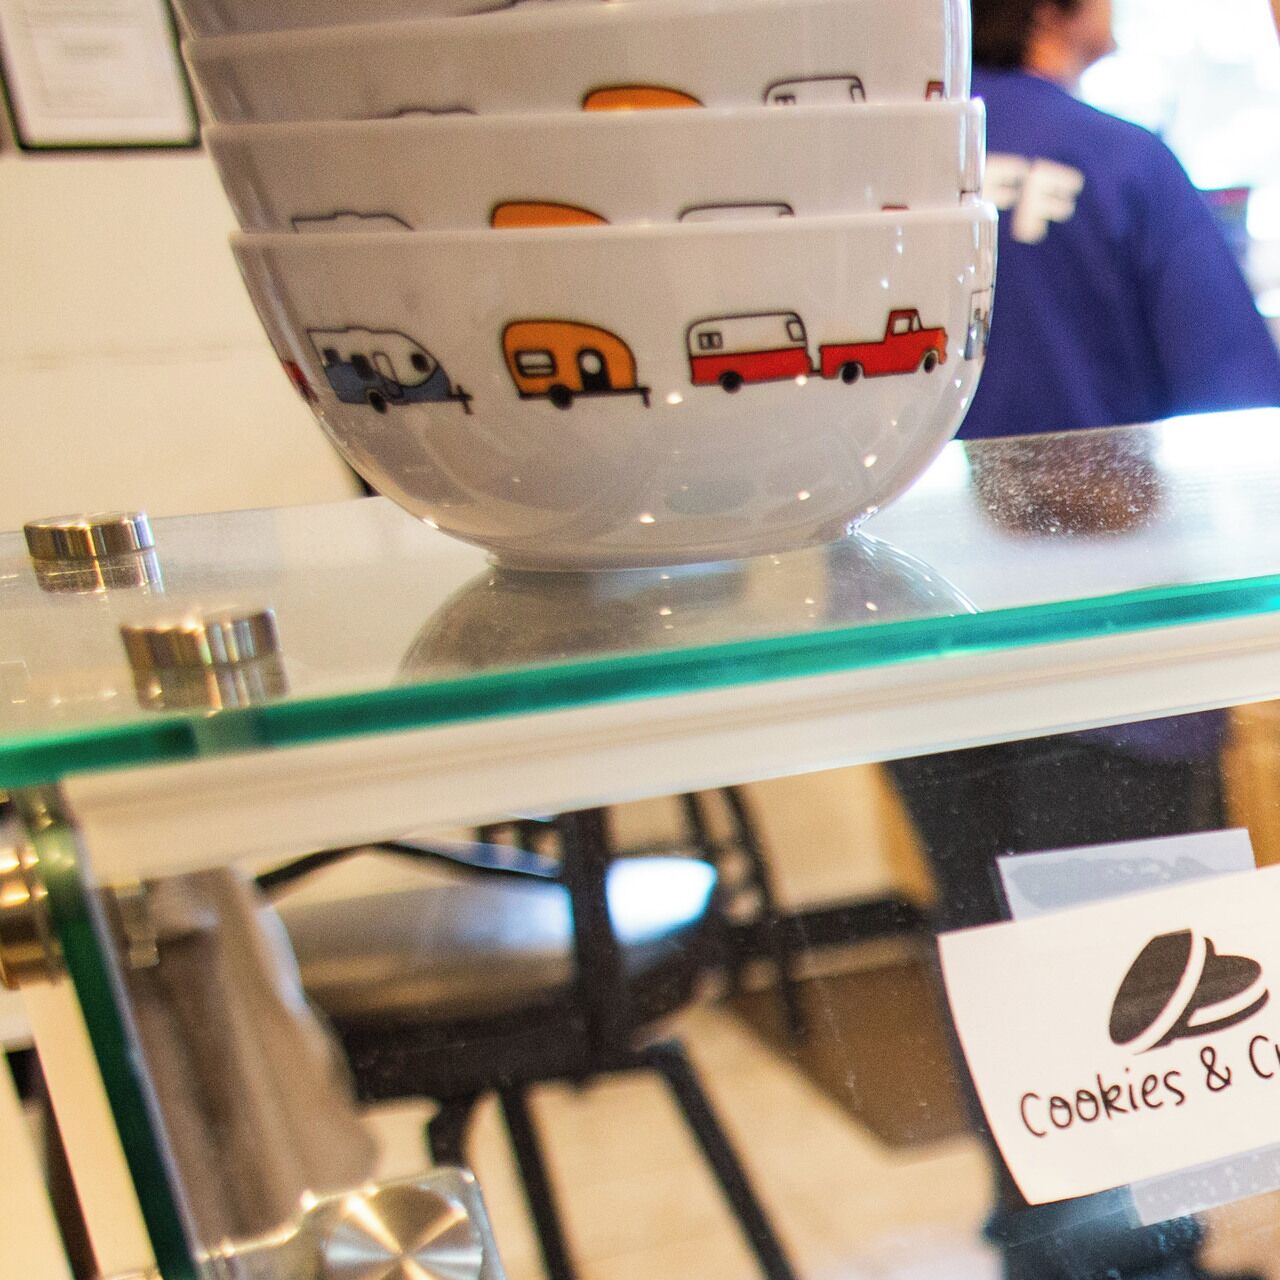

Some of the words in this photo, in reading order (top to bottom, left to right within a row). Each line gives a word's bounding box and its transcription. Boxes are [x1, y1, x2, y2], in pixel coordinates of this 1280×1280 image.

[984, 151, 1085, 245] FF
[1020, 1067, 1186, 1138] Cookies
[1200, 1046, 1232, 1092] &
